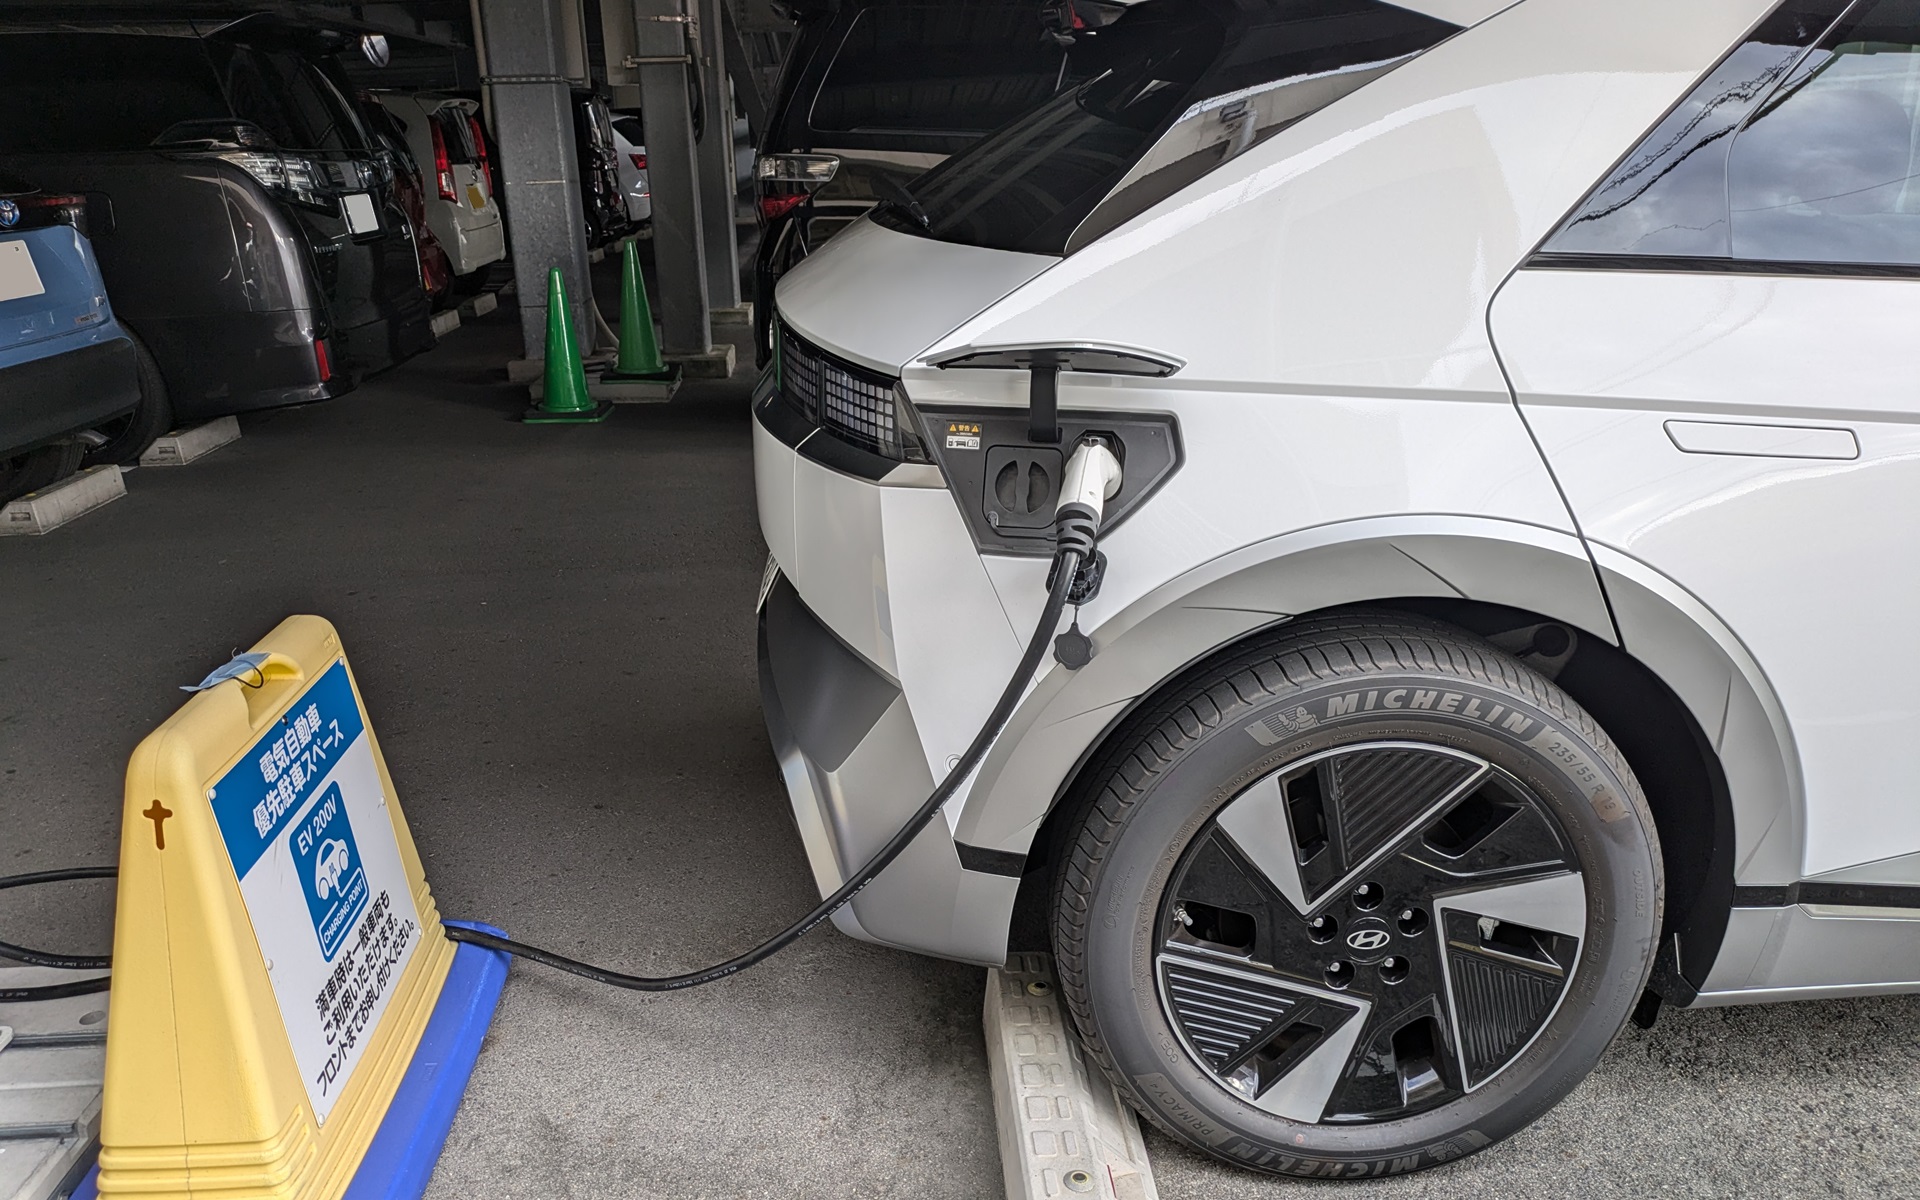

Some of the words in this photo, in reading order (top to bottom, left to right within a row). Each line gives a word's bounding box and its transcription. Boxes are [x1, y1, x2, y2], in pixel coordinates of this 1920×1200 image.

[259, 702, 322, 783] 電気自動車
[1324, 688, 1534, 735] MICHELIN
[253, 719, 344, 839] 優先駐車スペース
[1548, 742, 1596, 782] 235/55
[1591, 783, 1605, 795] R
[297, 824, 313, 857] EV
[313, 793, 337, 837] 200V
[323, 900, 350, 944] CHARGING
[349, 878, 363, 905] POINT
[1632, 869, 1644, 918] OUTSIDE
[315, 890, 390, 1021] 満車時は一般車両も
[323, 912, 399, 1045] ご利用いただけます。
[317, 918, 414, 1097] フロントまでお申し付けください。
[1154, 1090, 1214, 1135] PRIMACY
[1230, 1142, 1420, 1177] MICHELIN
